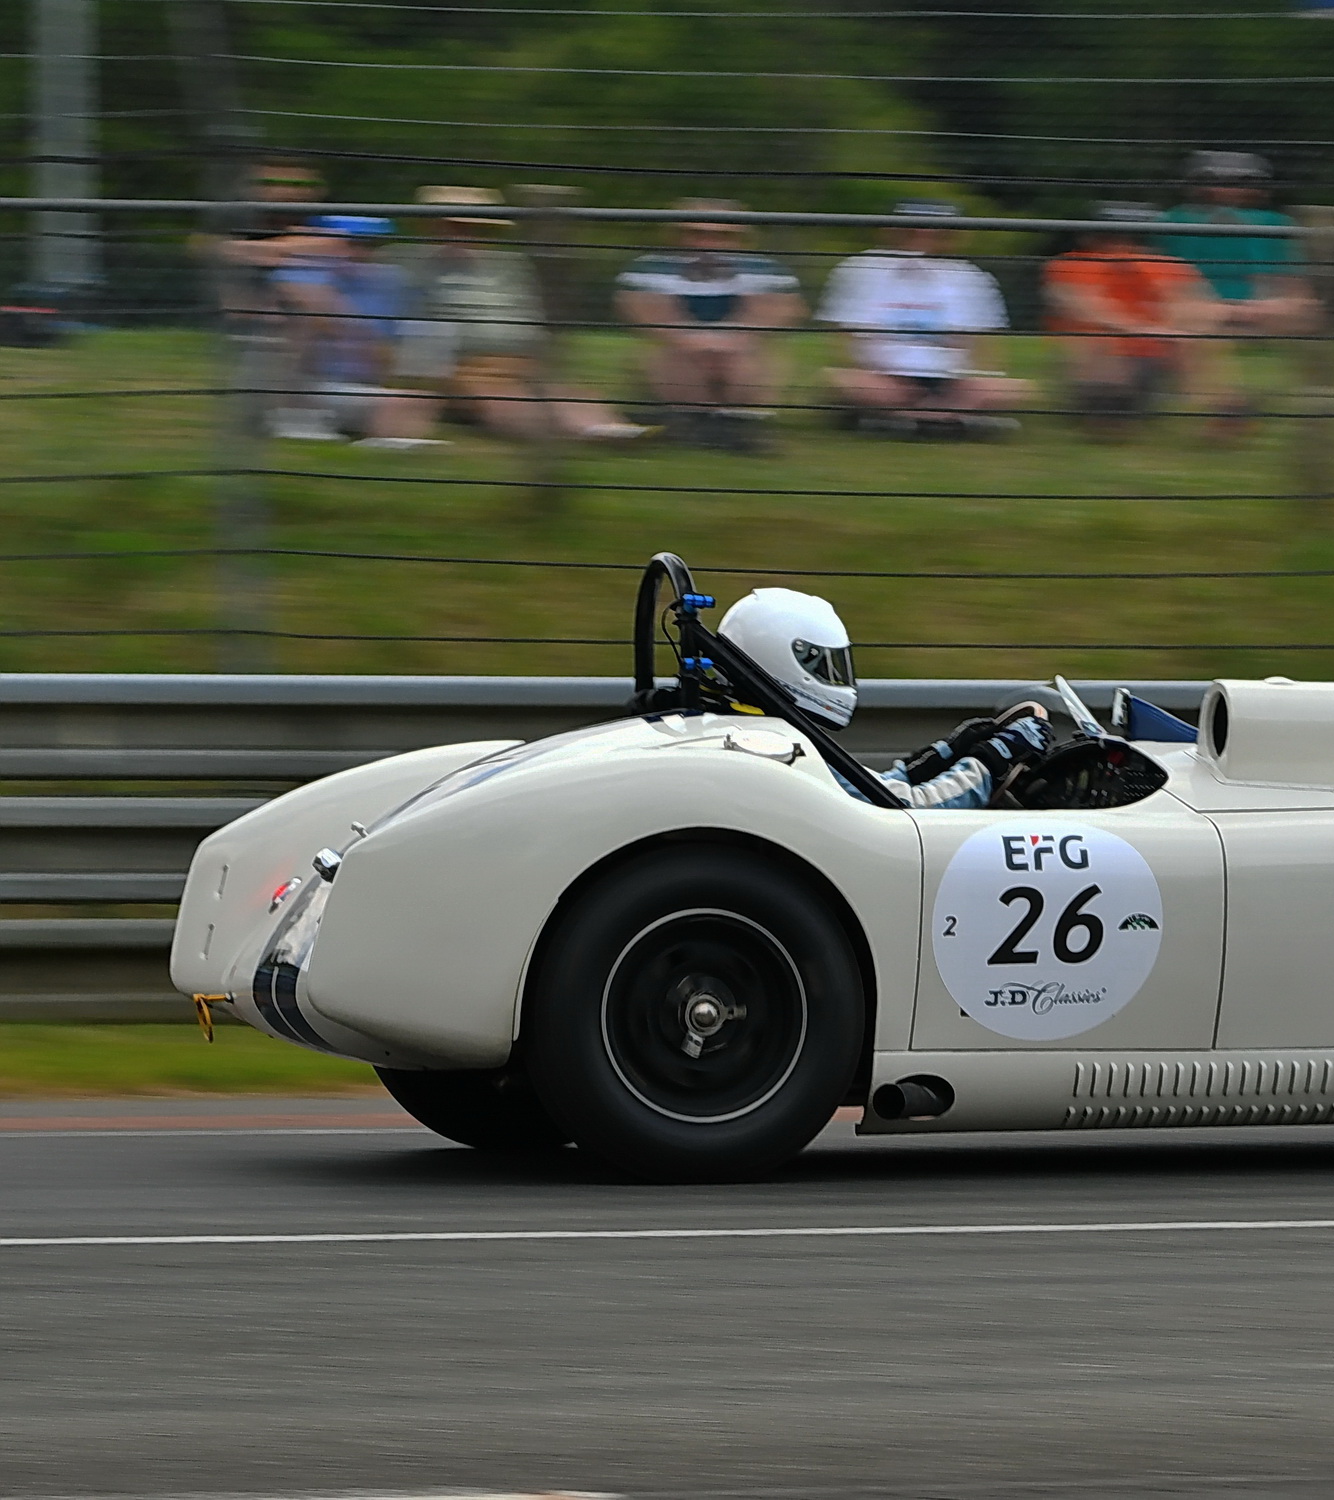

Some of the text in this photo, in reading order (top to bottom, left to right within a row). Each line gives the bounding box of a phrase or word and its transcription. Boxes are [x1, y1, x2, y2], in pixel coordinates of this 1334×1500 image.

[1001, 834, 1090, 871] EFG
[943, 916, 957, 937] 2
[987, 884, 1104, 966] 26
